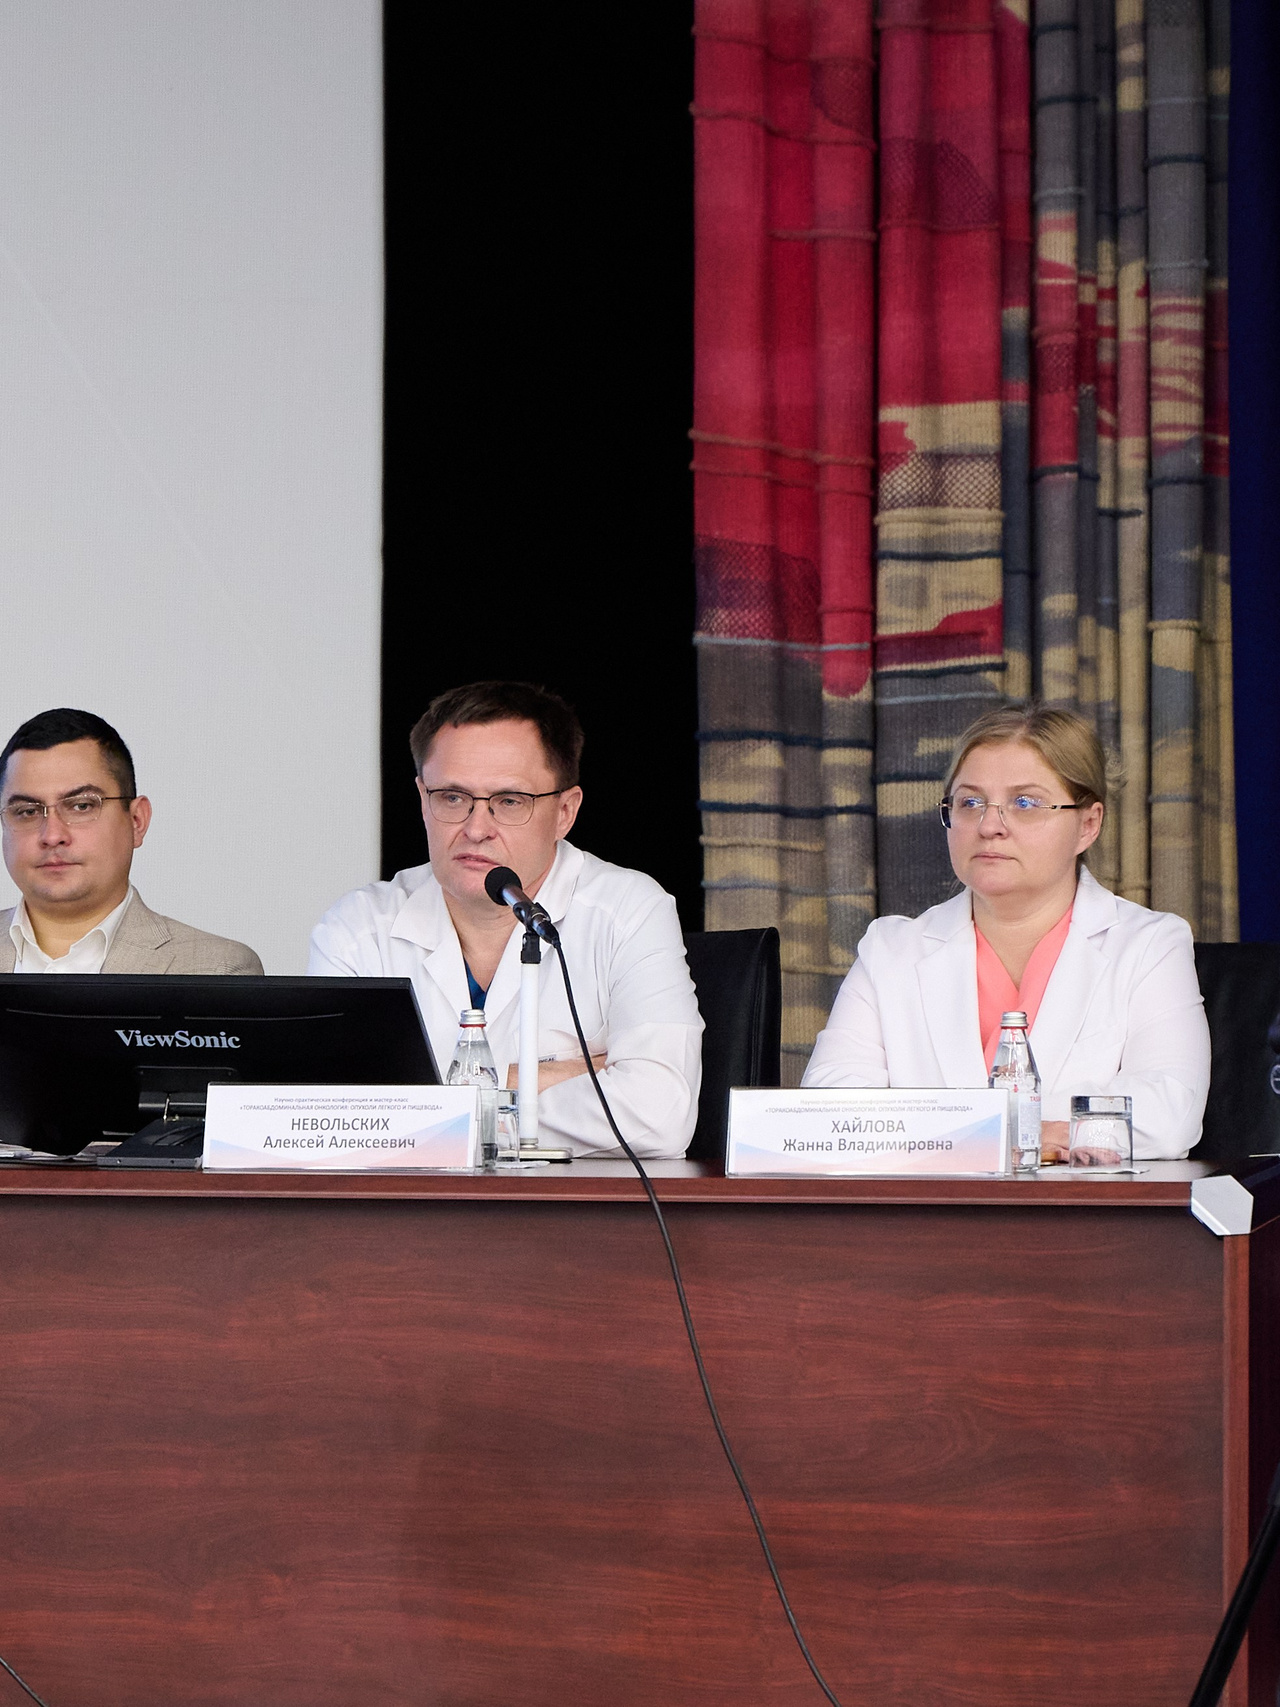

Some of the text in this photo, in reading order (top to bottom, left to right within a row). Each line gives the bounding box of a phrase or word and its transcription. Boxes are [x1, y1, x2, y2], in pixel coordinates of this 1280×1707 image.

[114, 1029, 241, 1049] ViewSonic
[291, 1118, 390, 1131] НЕВОЛЬСКИХ
[831, 1116, 906, 1133] ХАЙЛОВА
[263, 1134, 415, 1148] Алексей Алексеевич
[783, 1138, 953, 1154] Жанна Владимировна
